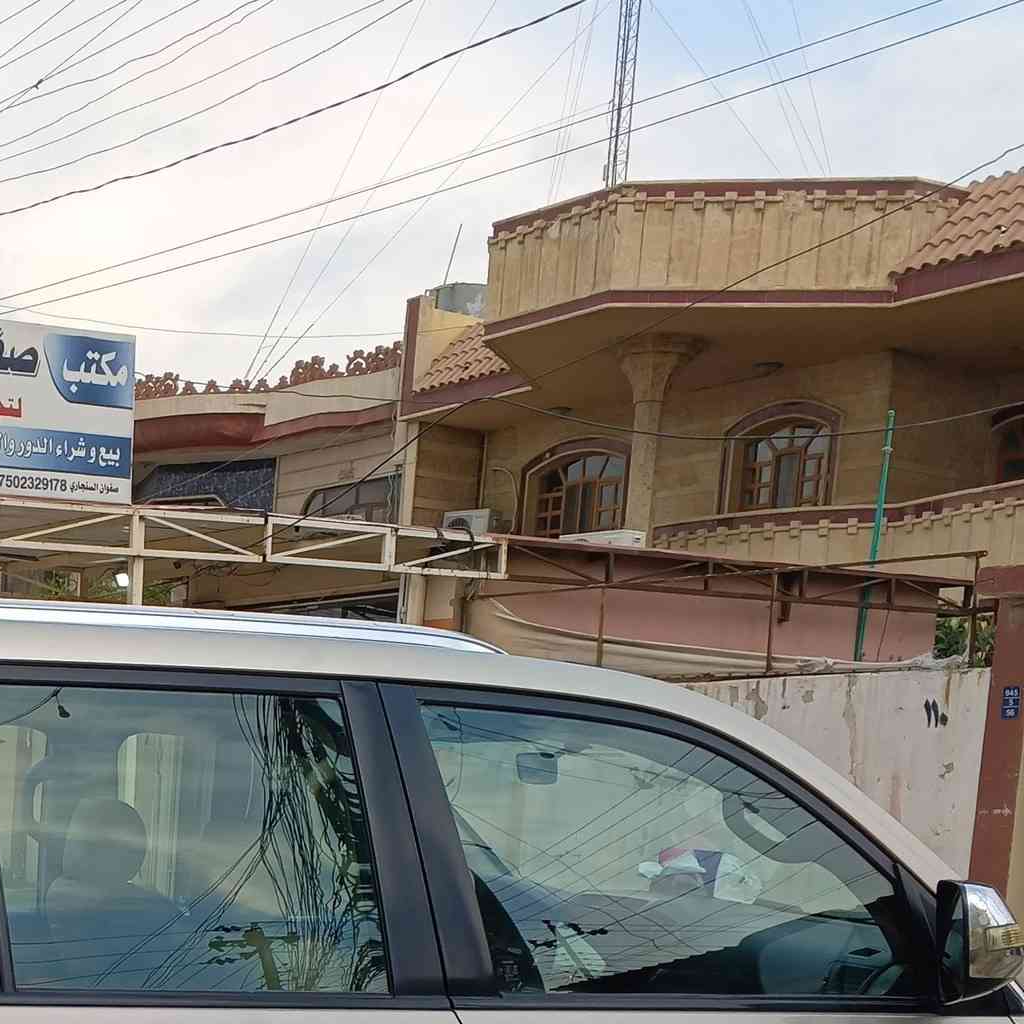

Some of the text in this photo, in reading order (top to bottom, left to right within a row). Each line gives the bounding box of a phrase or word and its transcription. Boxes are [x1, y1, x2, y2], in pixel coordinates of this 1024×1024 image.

[62, 350, 128, 393] مكتب
[16, 436, 53, 458] الدور
[98, 446, 121, 467] بيع
